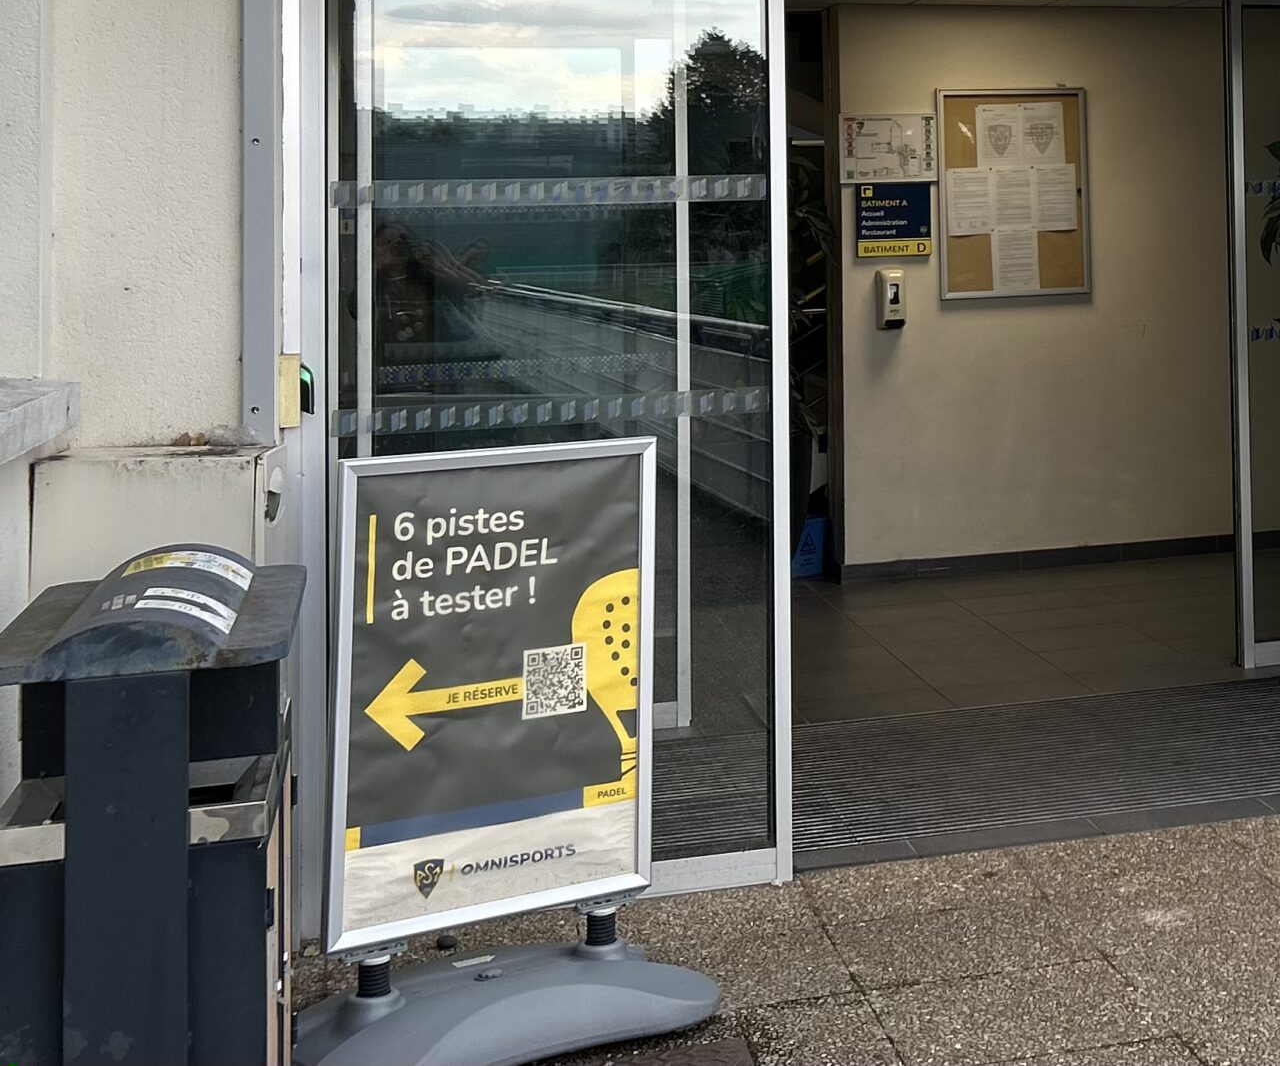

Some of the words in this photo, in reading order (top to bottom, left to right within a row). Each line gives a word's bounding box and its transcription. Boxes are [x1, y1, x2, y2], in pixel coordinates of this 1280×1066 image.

[863, 245, 909, 253] BATIMENT
[917, 242, 927, 253] D
[394, 511, 415, 541] 6
[426, 508, 525, 546] pistes
[392, 551, 434, 581] de
[446, 537, 558, 576] PADEL
[391, 589, 410, 621] à
[420, 585, 519, 617] tester
[446, 692, 460, 704] JE
[463, 683, 519, 702] RÉSERVE
[597, 787, 627, 799] PADEL
[460, 844, 577, 876] OMNISPORTS
